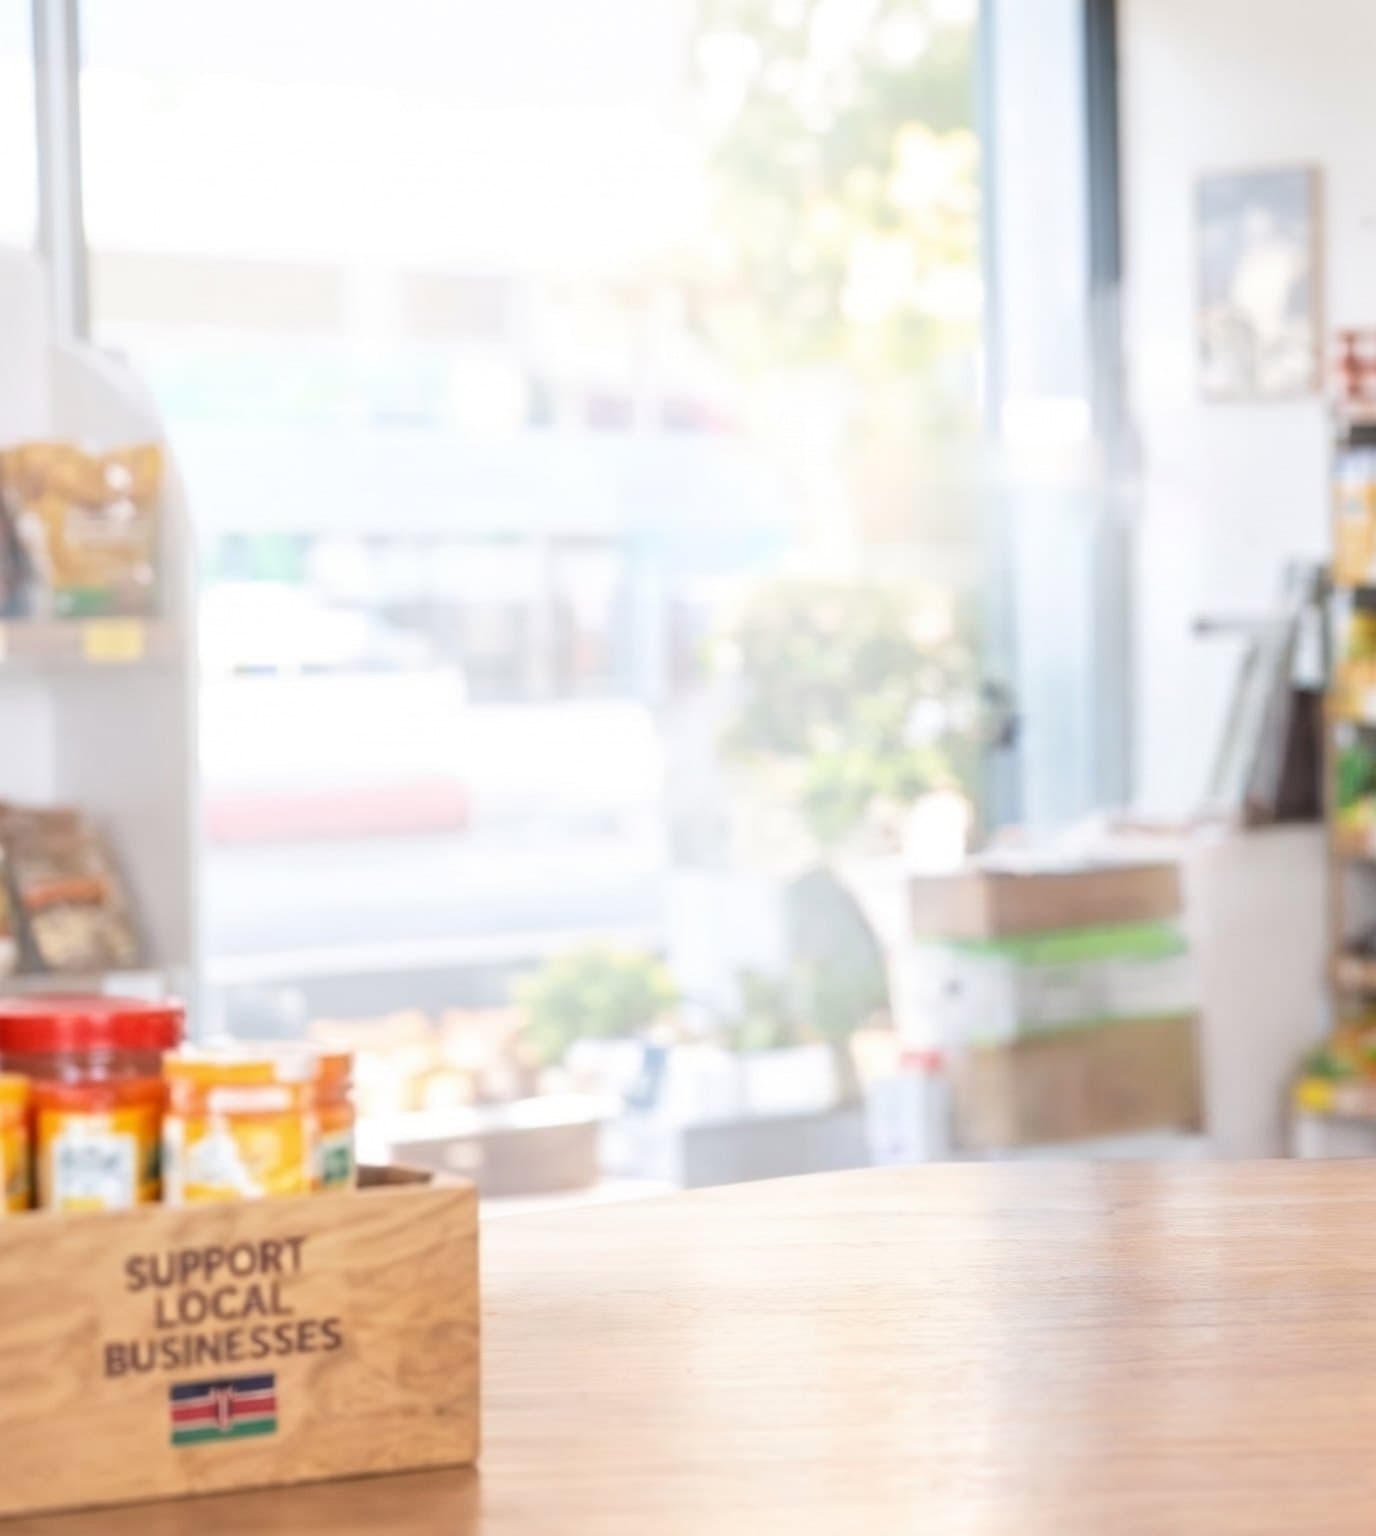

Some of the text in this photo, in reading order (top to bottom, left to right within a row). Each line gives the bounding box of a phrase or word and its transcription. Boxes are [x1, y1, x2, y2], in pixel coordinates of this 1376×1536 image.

[125, 1237, 306, 1291] SUPPORT
[156, 1283, 293, 1329] LOCAL
[105, 1318, 343, 1377] BUSINESSES
